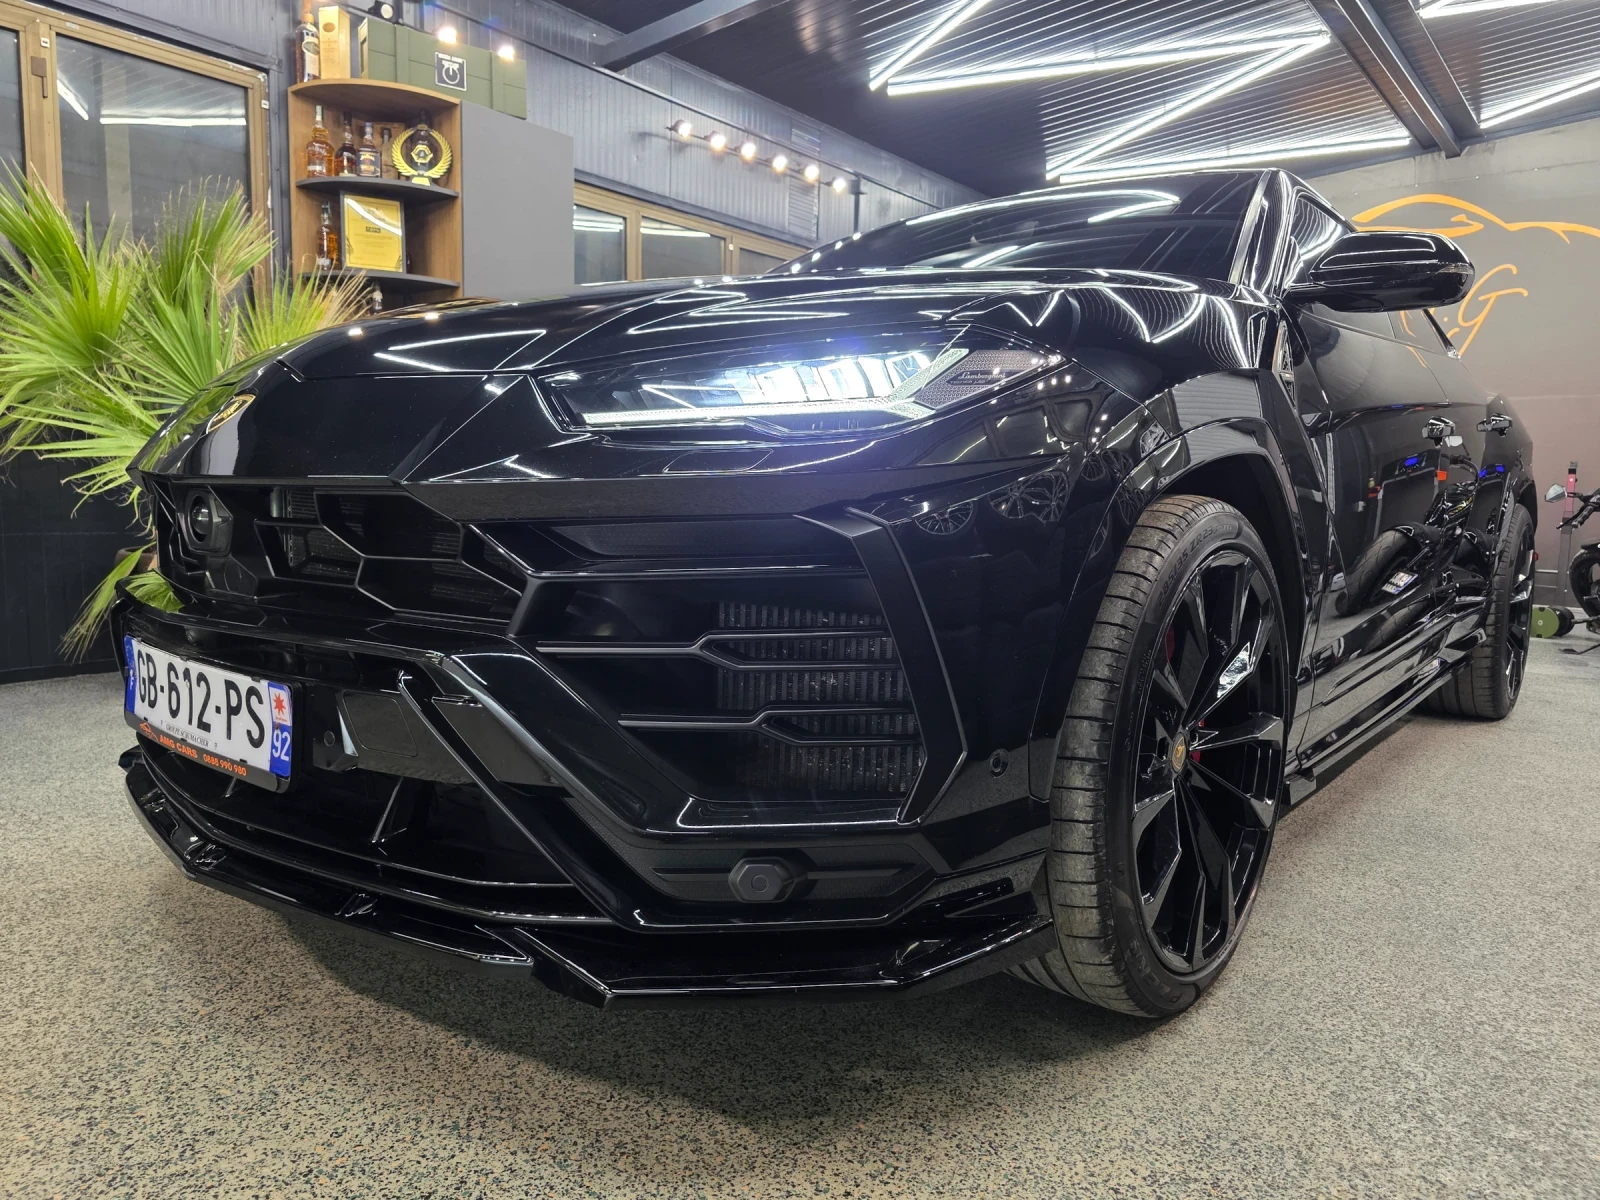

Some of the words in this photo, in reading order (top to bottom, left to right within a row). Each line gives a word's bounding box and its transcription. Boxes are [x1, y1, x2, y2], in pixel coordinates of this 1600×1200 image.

[958, 371, 1006, 382] Lamborghini
[137, 649, 265, 748] GB-612-PS
[160, 734, 175, 749] AMG
[176, 742, 198, 758] CARS
[203, 753, 219, 767] 0888
[220, 759, 233, 771] 990
[272, 731, 290, 761] 92
